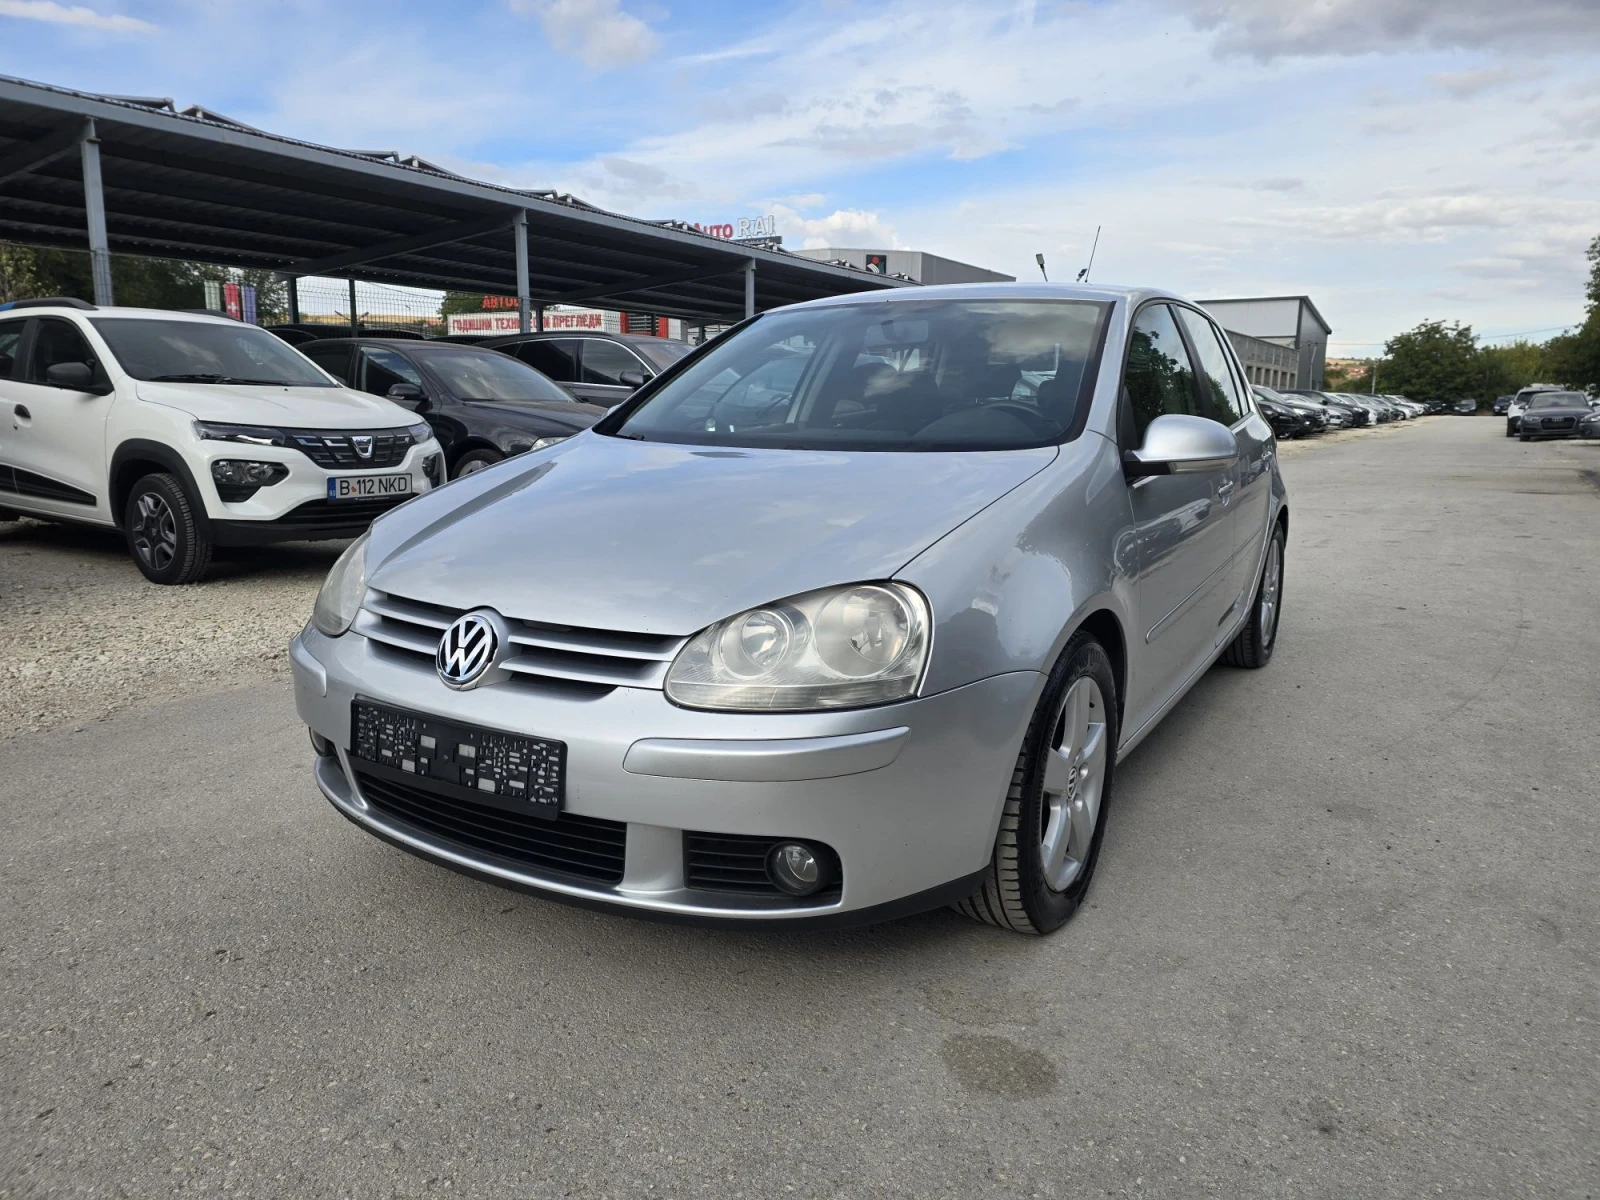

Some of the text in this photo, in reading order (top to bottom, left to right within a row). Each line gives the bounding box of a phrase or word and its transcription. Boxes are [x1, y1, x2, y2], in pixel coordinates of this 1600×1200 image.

[552, 313, 602, 329] ПРЕГЛЕДИ
[340, 480, 350, 496] B
[357, 478, 375, 495] 112
[379, 476, 408, 494] NKD
